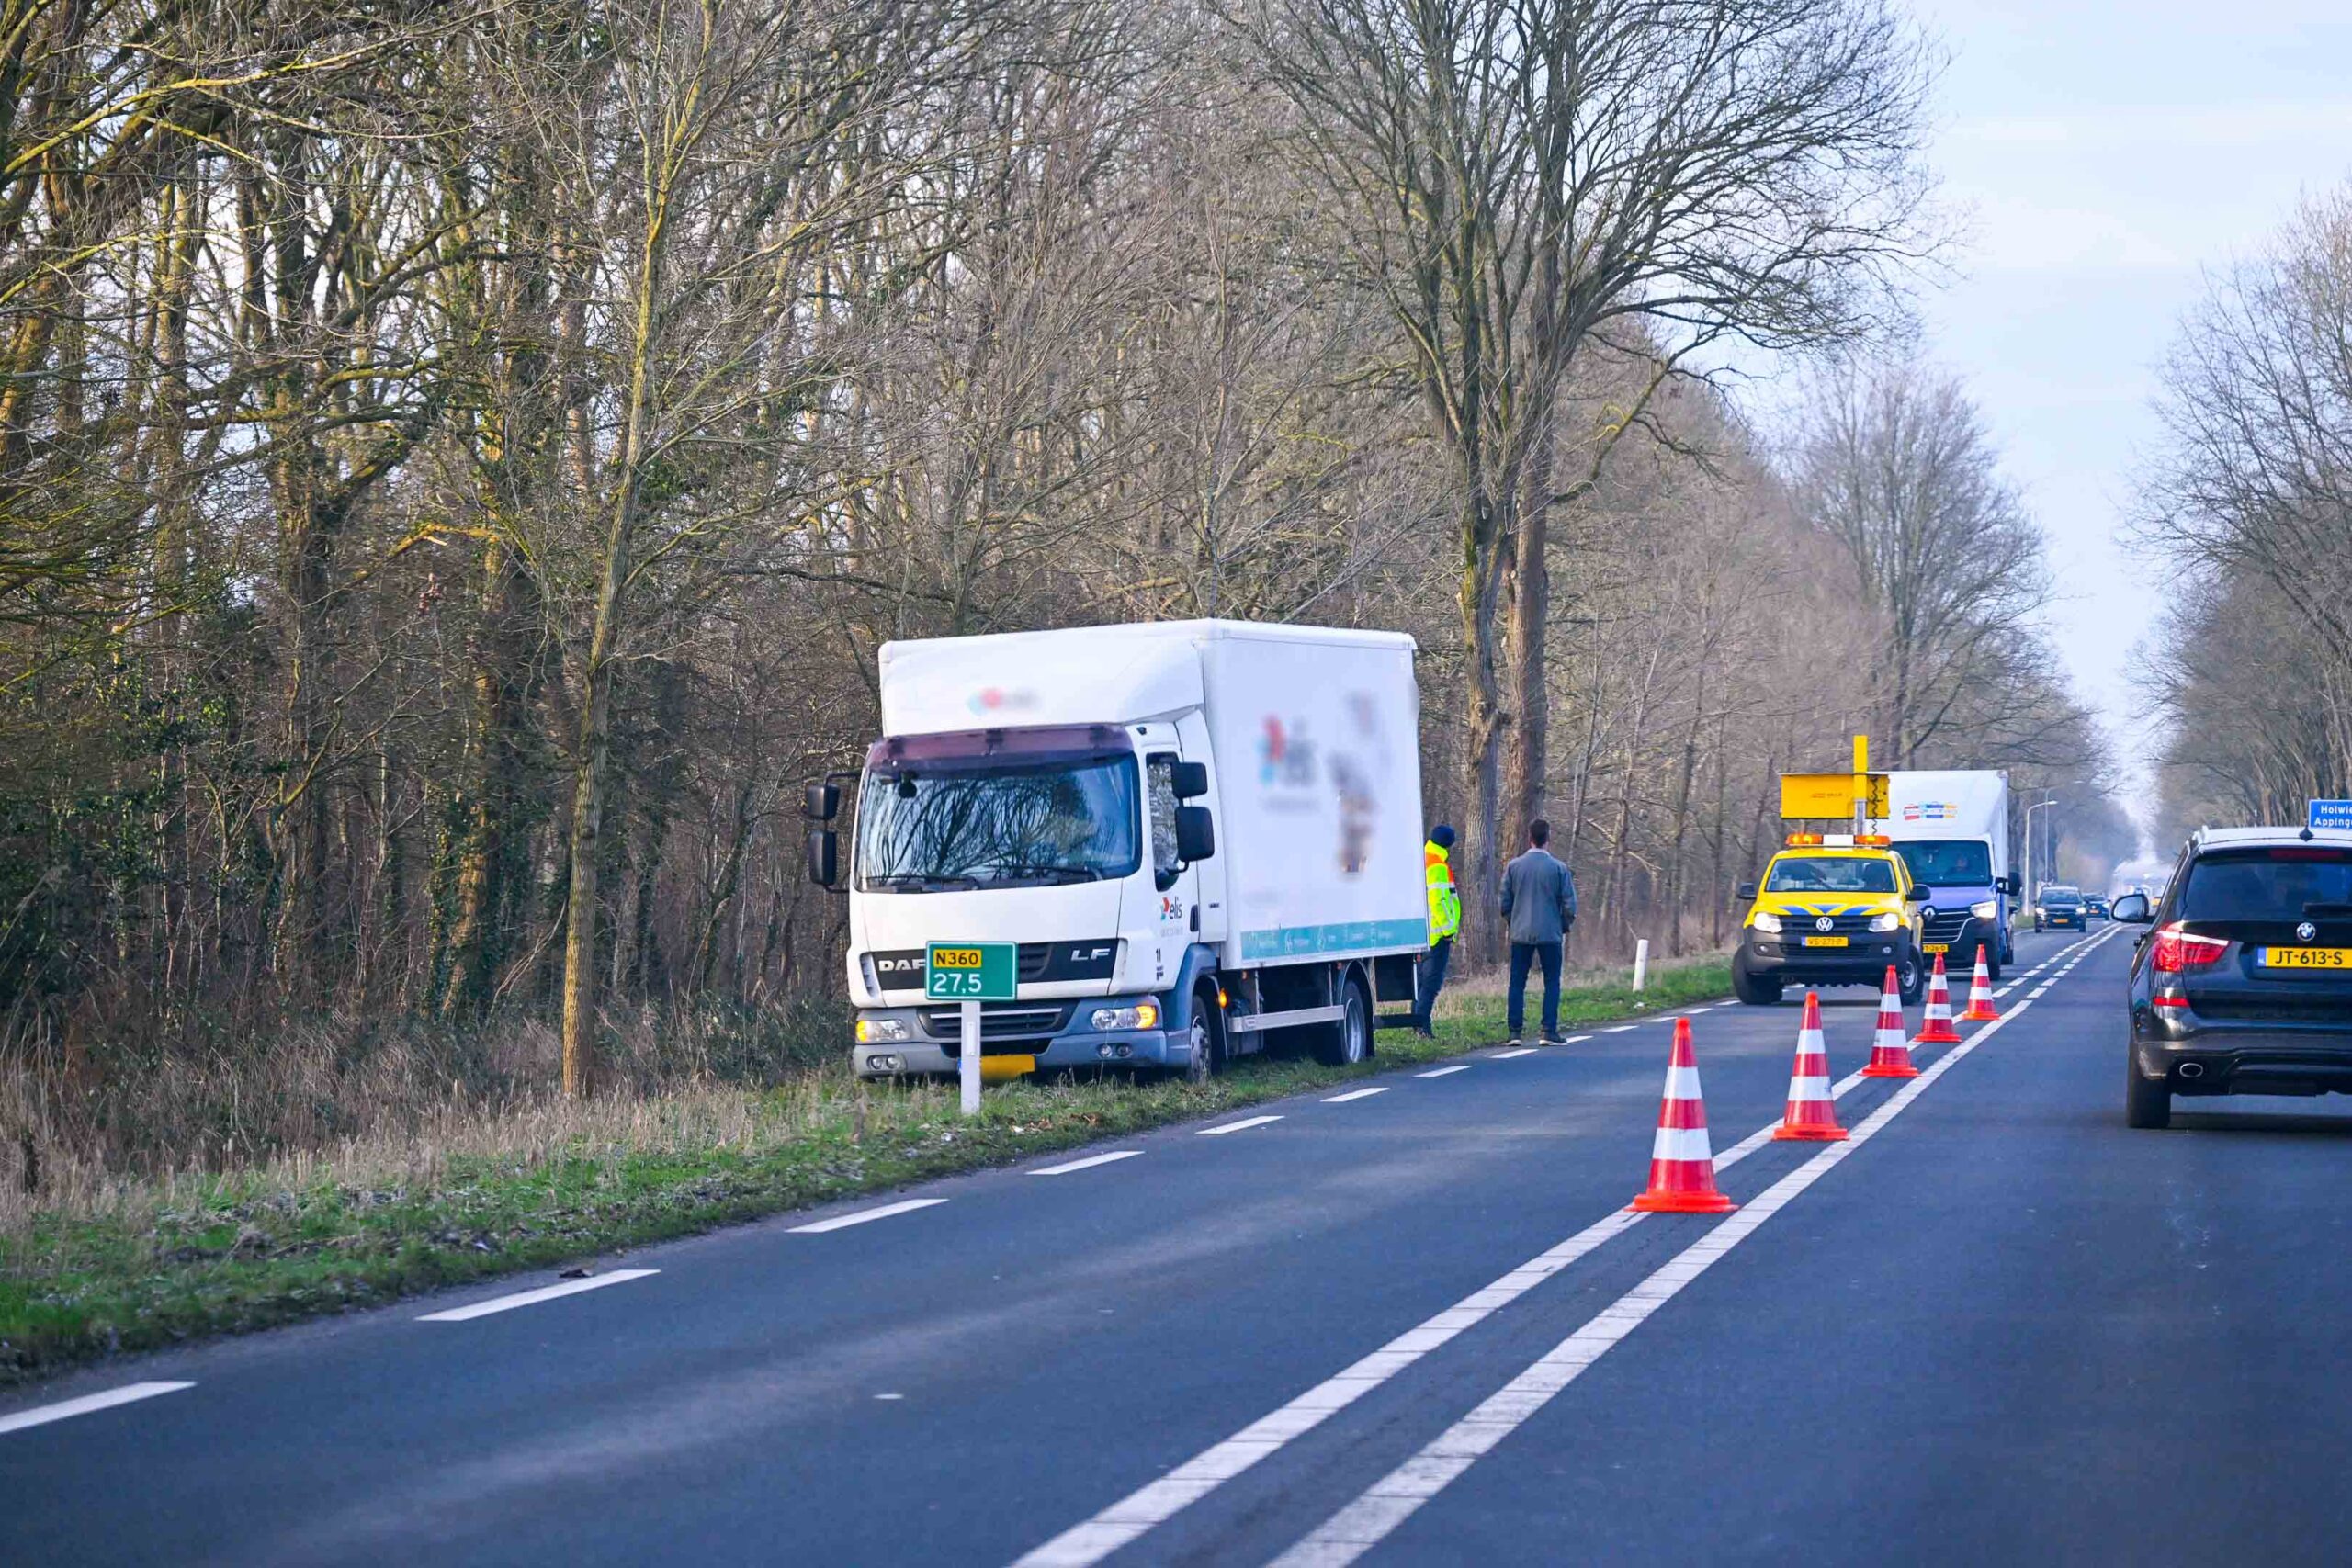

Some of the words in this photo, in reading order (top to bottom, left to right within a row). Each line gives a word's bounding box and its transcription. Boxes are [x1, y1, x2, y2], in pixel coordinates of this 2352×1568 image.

[2314, 817, 2352, 829] Apping
[935, 952, 978, 965] N360
[1070, 948, 1111, 962] LF
[2275, 950, 2343, 965] JT-613-S
[878, 959, 926, 972] DAF
[933, 973, 982, 994] 27,5
